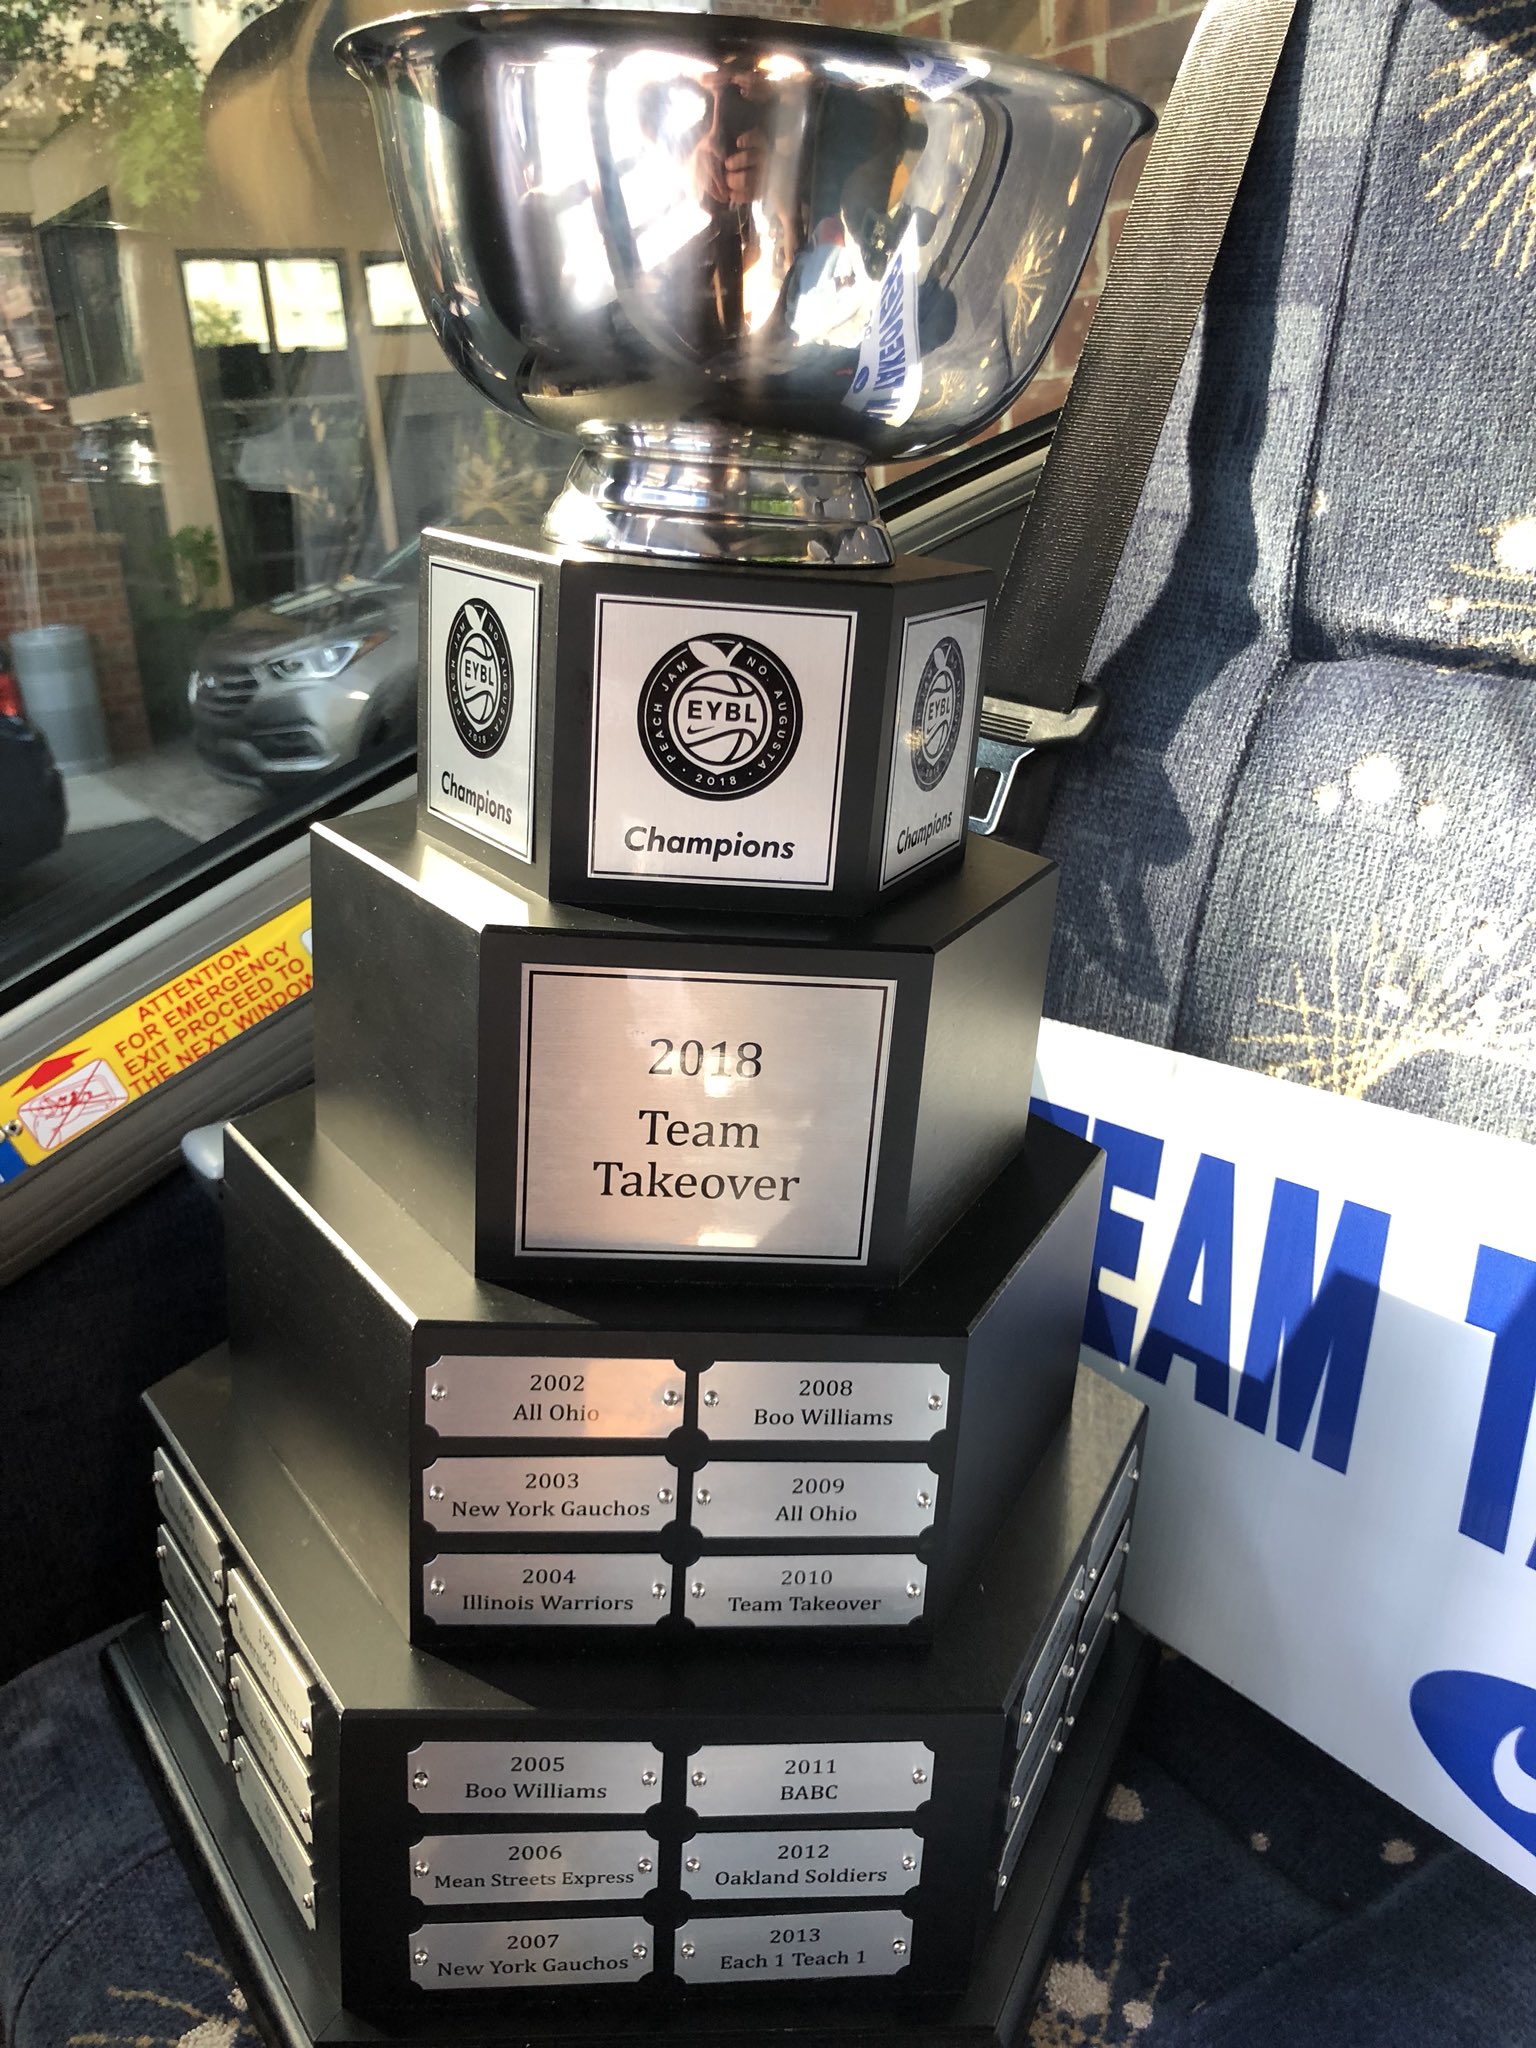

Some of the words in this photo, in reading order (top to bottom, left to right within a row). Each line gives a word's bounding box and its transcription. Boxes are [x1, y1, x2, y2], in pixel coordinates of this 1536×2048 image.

[454, 622, 466, 649] JAM
[464, 659, 494, 687] EYBL
[661, 660, 688, 692] JAM
[747, 657, 770, 682] NO.
[494, 656, 509, 733] AUGUSTA
[687, 699, 757, 723] EYBL
[928, 697, 950, 721] EYBL
[468, 729, 487, 744] 2018
[653, 703, 676, 764] PEACH
[758, 689, 788, 770] AUGUSTA
[695, 773, 737, 786] 2018
[441, 770, 513, 825] Champions
[896, 811, 953, 855] Champions
[624, 826, 796, 862] Champions
[137, 944, 251, 1022] ATTENTION
[114, 1022, 162, 1058] FOR
[162, 940, 290, 1028] EMERGENCY
[123, 1038, 171, 1076] EXIT
[174, 977, 274, 1045] PROCEED
[274, 958, 305, 982] TO
[128, 1061, 177, 1096] THE
[175, 1024, 230, 1070] NEXT
[648, 1038, 763, 1078] 2018
[639, 1110, 760, 1149] Team
[593, 1161, 800, 1202] Takeover
[1030, 1096, 1391, 1476] EAM
[530, 1374, 585, 1392] 2002
[799, 1380, 853, 1396] 2008
[513, 1404, 542, 1421] All
[550, 1404, 600, 1422] Ohio
[754, 1408, 795, 1425] Boo
[800, 1408, 893, 1425] Williams
[525, 1473, 579, 1489] 2003
[792, 1478, 845, 1494] 2009
[451, 1501, 500, 1517] New
[506, 1501, 555, 1517] York
[561, 1500, 650, 1517] Gauchos
[774, 1505, 803, 1521] All
[810, 1505, 857, 1521] Ohio
[522, 1569, 576, 1584] 2004
[781, 1570, 833, 1585] 2010
[462, 1595, 534, 1610] Illinois
[540, 1595, 633, 1610] Warriors
[728, 1596, 782, 1612] Team
[789, 1596, 881, 1611] Takeover
[510, 1756, 565, 1772] 2005
[785, 1759, 837, 1775] 2011
[465, 1783, 506, 1799] Boo
[513, 1783, 607, 1799] Williams
[780, 1784, 838, 1800] BABC
[508, 1845, 562, 1861] 2006
[777, 1844, 829, 1859] 2012
[434, 1875, 485, 1889] Mean
[491, 1872, 556, 1887] Streets
[562, 1871, 634, 1887] Express
[715, 1870, 799, 1886] Oakland
[805, 1868, 887, 1883] Soldiers
[507, 1934, 559, 1949] 2007
[770, 1928, 820, 1944] 2013
[437, 1962, 483, 1976] New
[489, 1959, 536, 1975] York
[543, 1956, 629, 1973] Gauchos
[720, 1954, 767, 1970] Each
[775, 1953, 784, 1967] 1
[792, 1951, 848, 1966] Teach
[857, 1950, 866, 1963] 1
